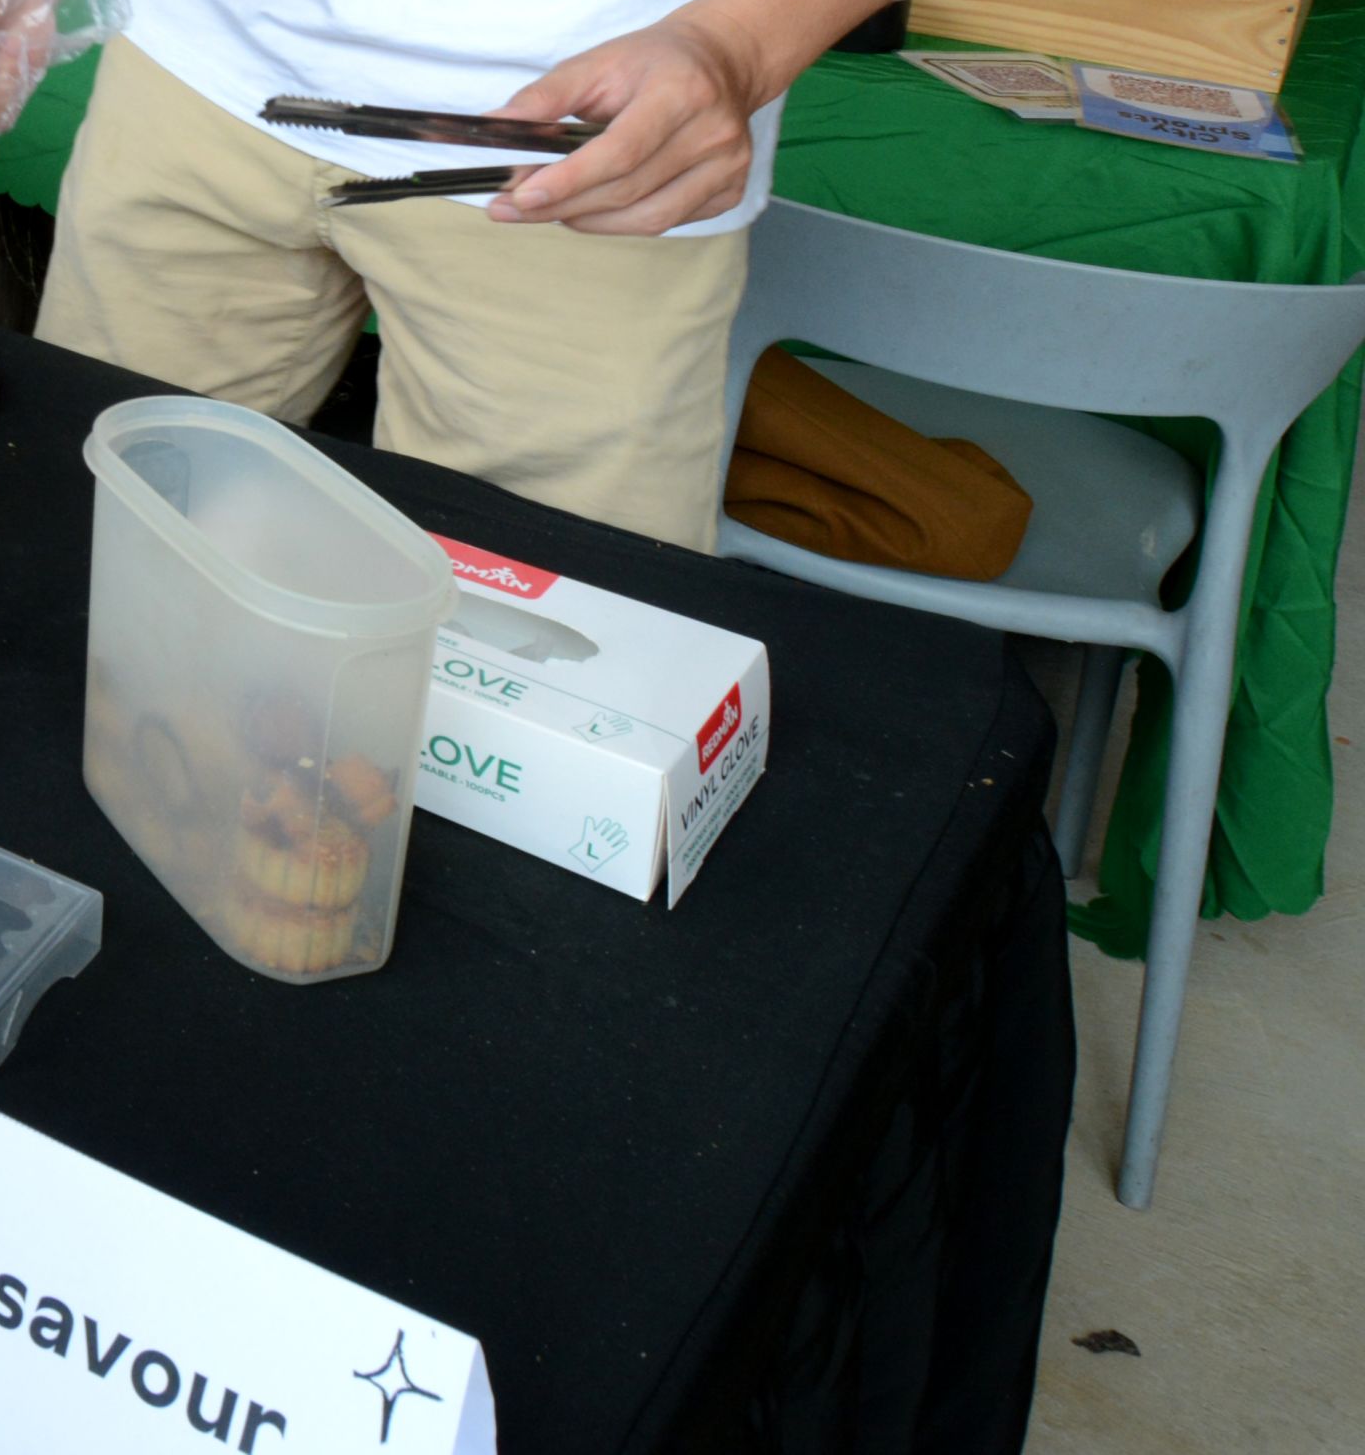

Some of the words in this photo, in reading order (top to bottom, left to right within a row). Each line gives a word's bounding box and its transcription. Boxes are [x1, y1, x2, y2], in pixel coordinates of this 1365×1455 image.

[1117, 110, 1252, 141] Sprouts
[1151, 124, 1220, 143] City
[451, 559, 532, 592] DMAN
[432, 659, 528, 701] OVE
[590, 723, 602, 736] L
[420, 735, 522, 794] OVE
[681, 774, 718, 831] VINYL
[720, 714, 759, 781] GLOVE
[465, 780, 506, 802] 100PCS
[587, 842, 600, 860] L
